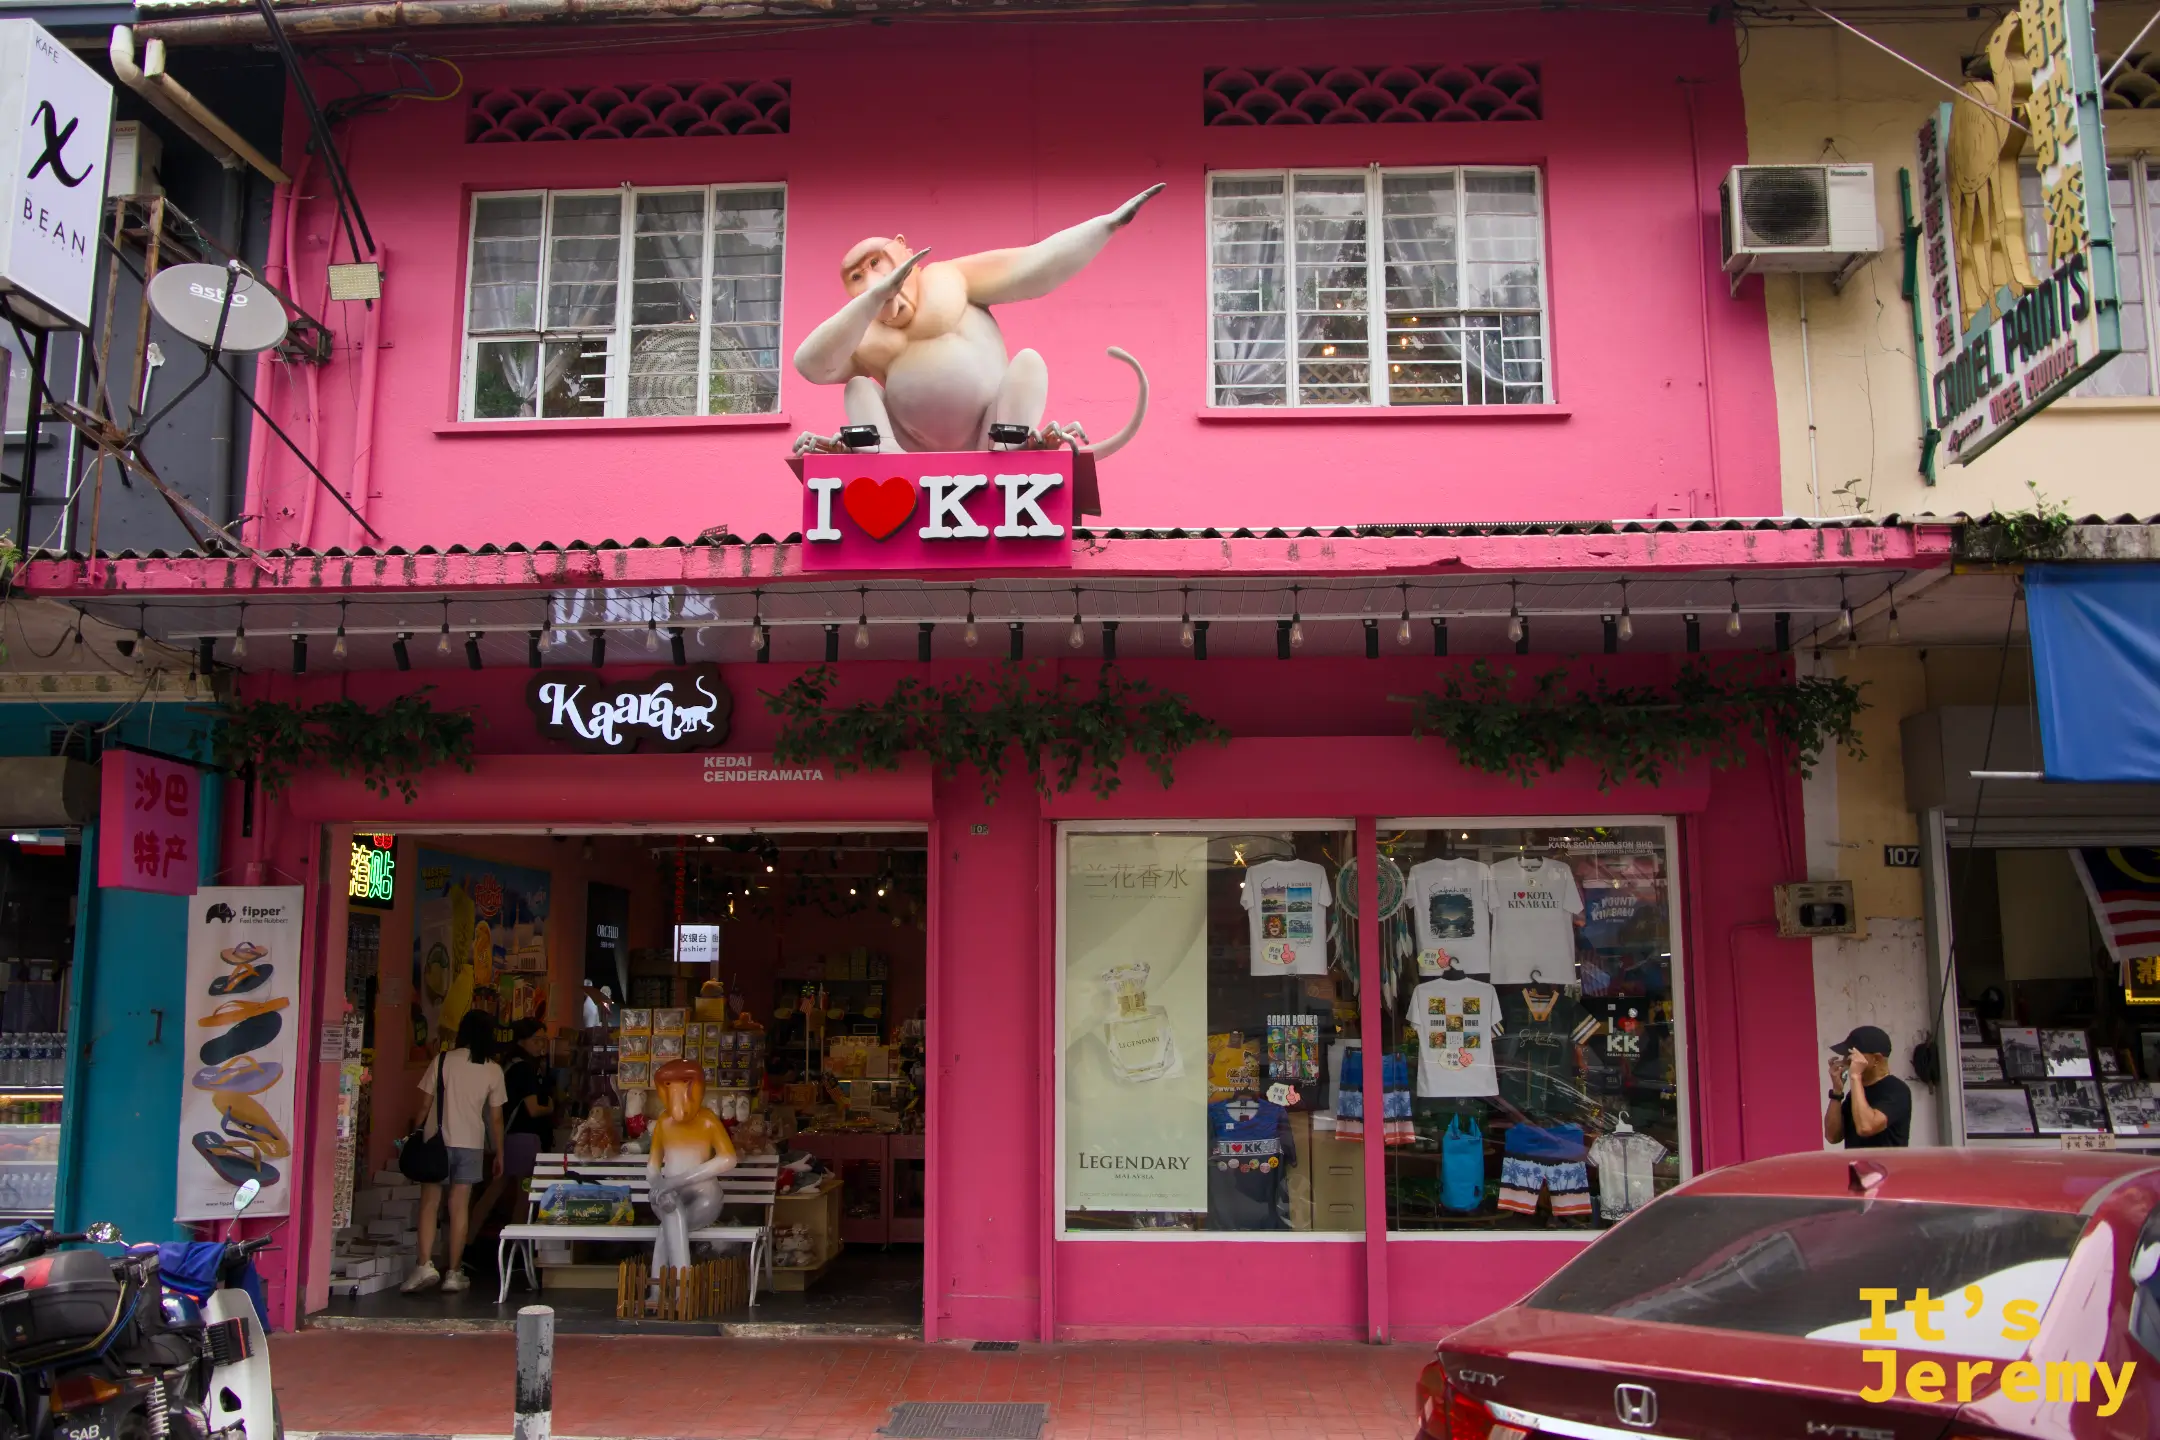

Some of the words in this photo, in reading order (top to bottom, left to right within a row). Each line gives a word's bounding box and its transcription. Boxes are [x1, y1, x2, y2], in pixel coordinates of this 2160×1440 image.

[35, 35, 59, 64] KAFE
[23, 197, 86, 256] BEAN
[190, 283, 249, 307] asto
[1932, 327, 2002, 429] CAMEL
[2001, 252, 2089, 374] PAINTS
[1989, 380, 2023, 425] MEE
[806, 477, 842, 542] I
[918, 473, 1065, 539] KK
[538, 681, 682, 745] Kaara
[703, 756, 753, 768] KEDAI
[703, 769, 824, 783] CENDERAMATA
[135, 766, 189, 818] 沙巴
[133, 829, 188, 880] 特产
[1888, 848, 1919, 866] 107
[1083, 863, 1189, 890] 兰花香水
[1508, 900, 1560, 909] KINABALU
[1513, 892, 1517, 900] I
[1526, 892, 1553, 900] KOTA
[242, 906, 281, 918] fipper
[596, 924, 619, 939] ORCHID
[680, 933, 707, 943] 收银台
[1118, 1036, 1160, 1049] LEGENDARY
[1607, 1035, 1640, 1053] KK
[1244, 1142, 1262, 1153] KK
[1079, 1152, 1191, 1170] LEGENDARY
[1459, 1370, 1504, 1387] CITY
